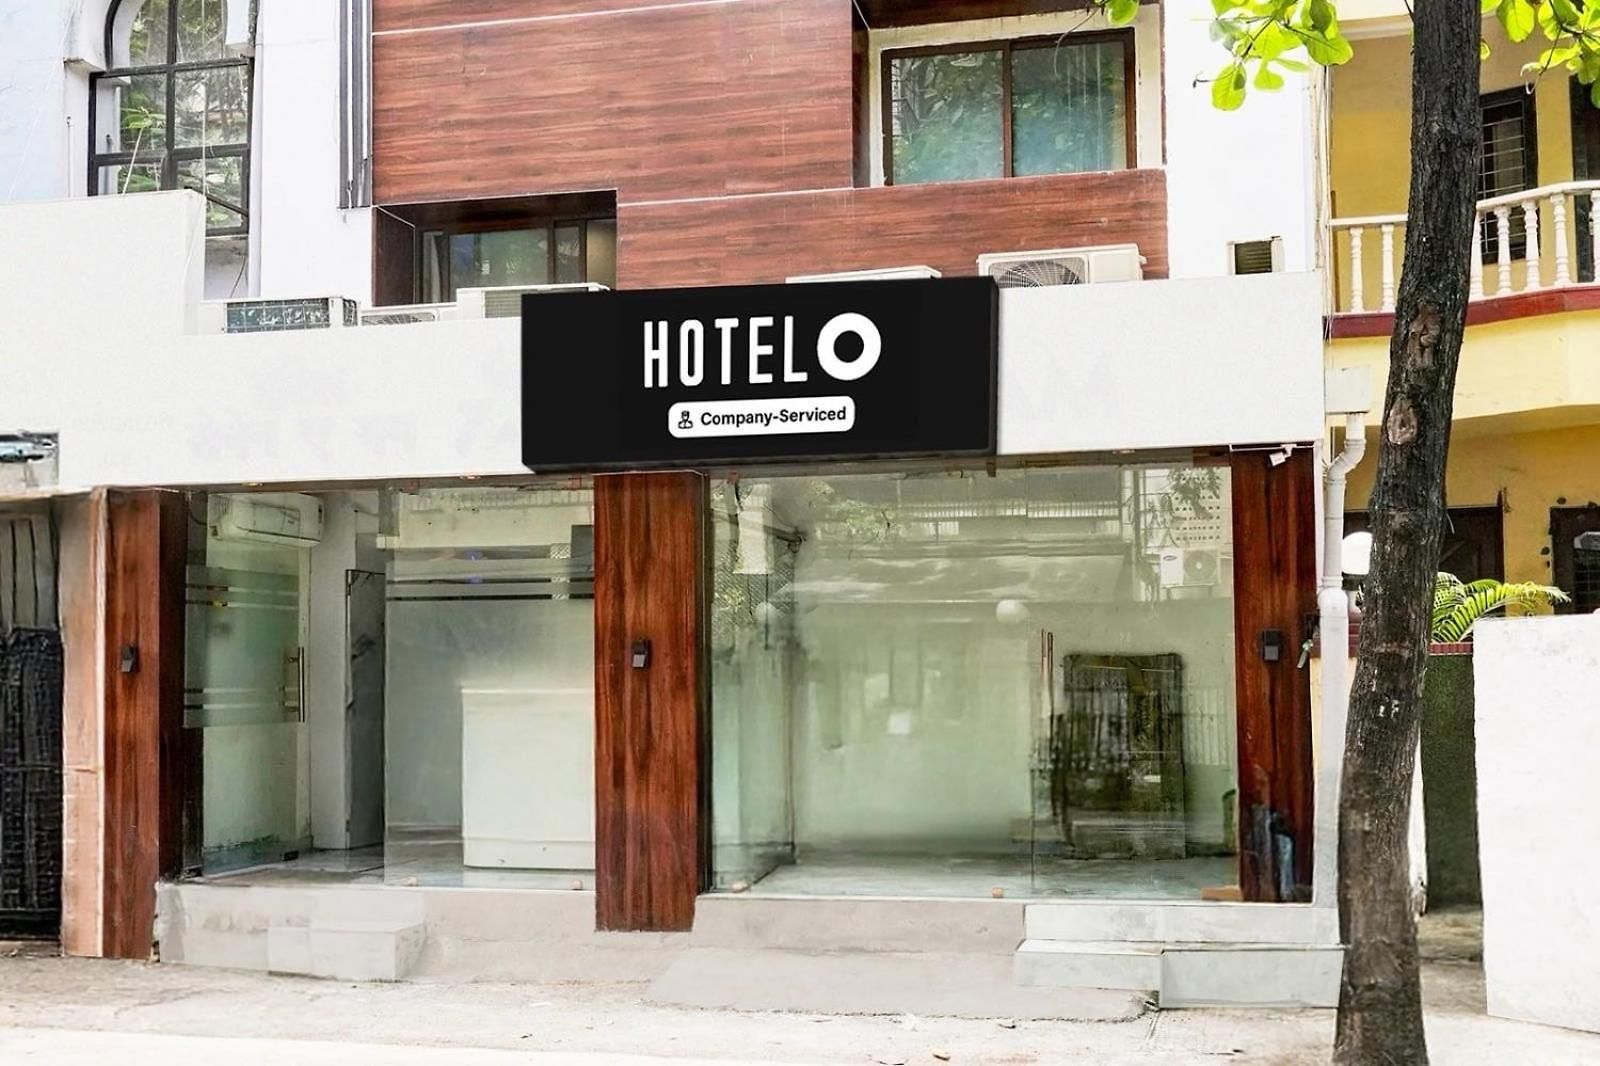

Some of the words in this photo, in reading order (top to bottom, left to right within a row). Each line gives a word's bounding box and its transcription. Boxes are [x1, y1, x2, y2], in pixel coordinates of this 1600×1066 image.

[643, 315, 808, 388] HOTEL
[816, 312, 882, 381] O
[700, 406, 847, 428] Company-Serviced
